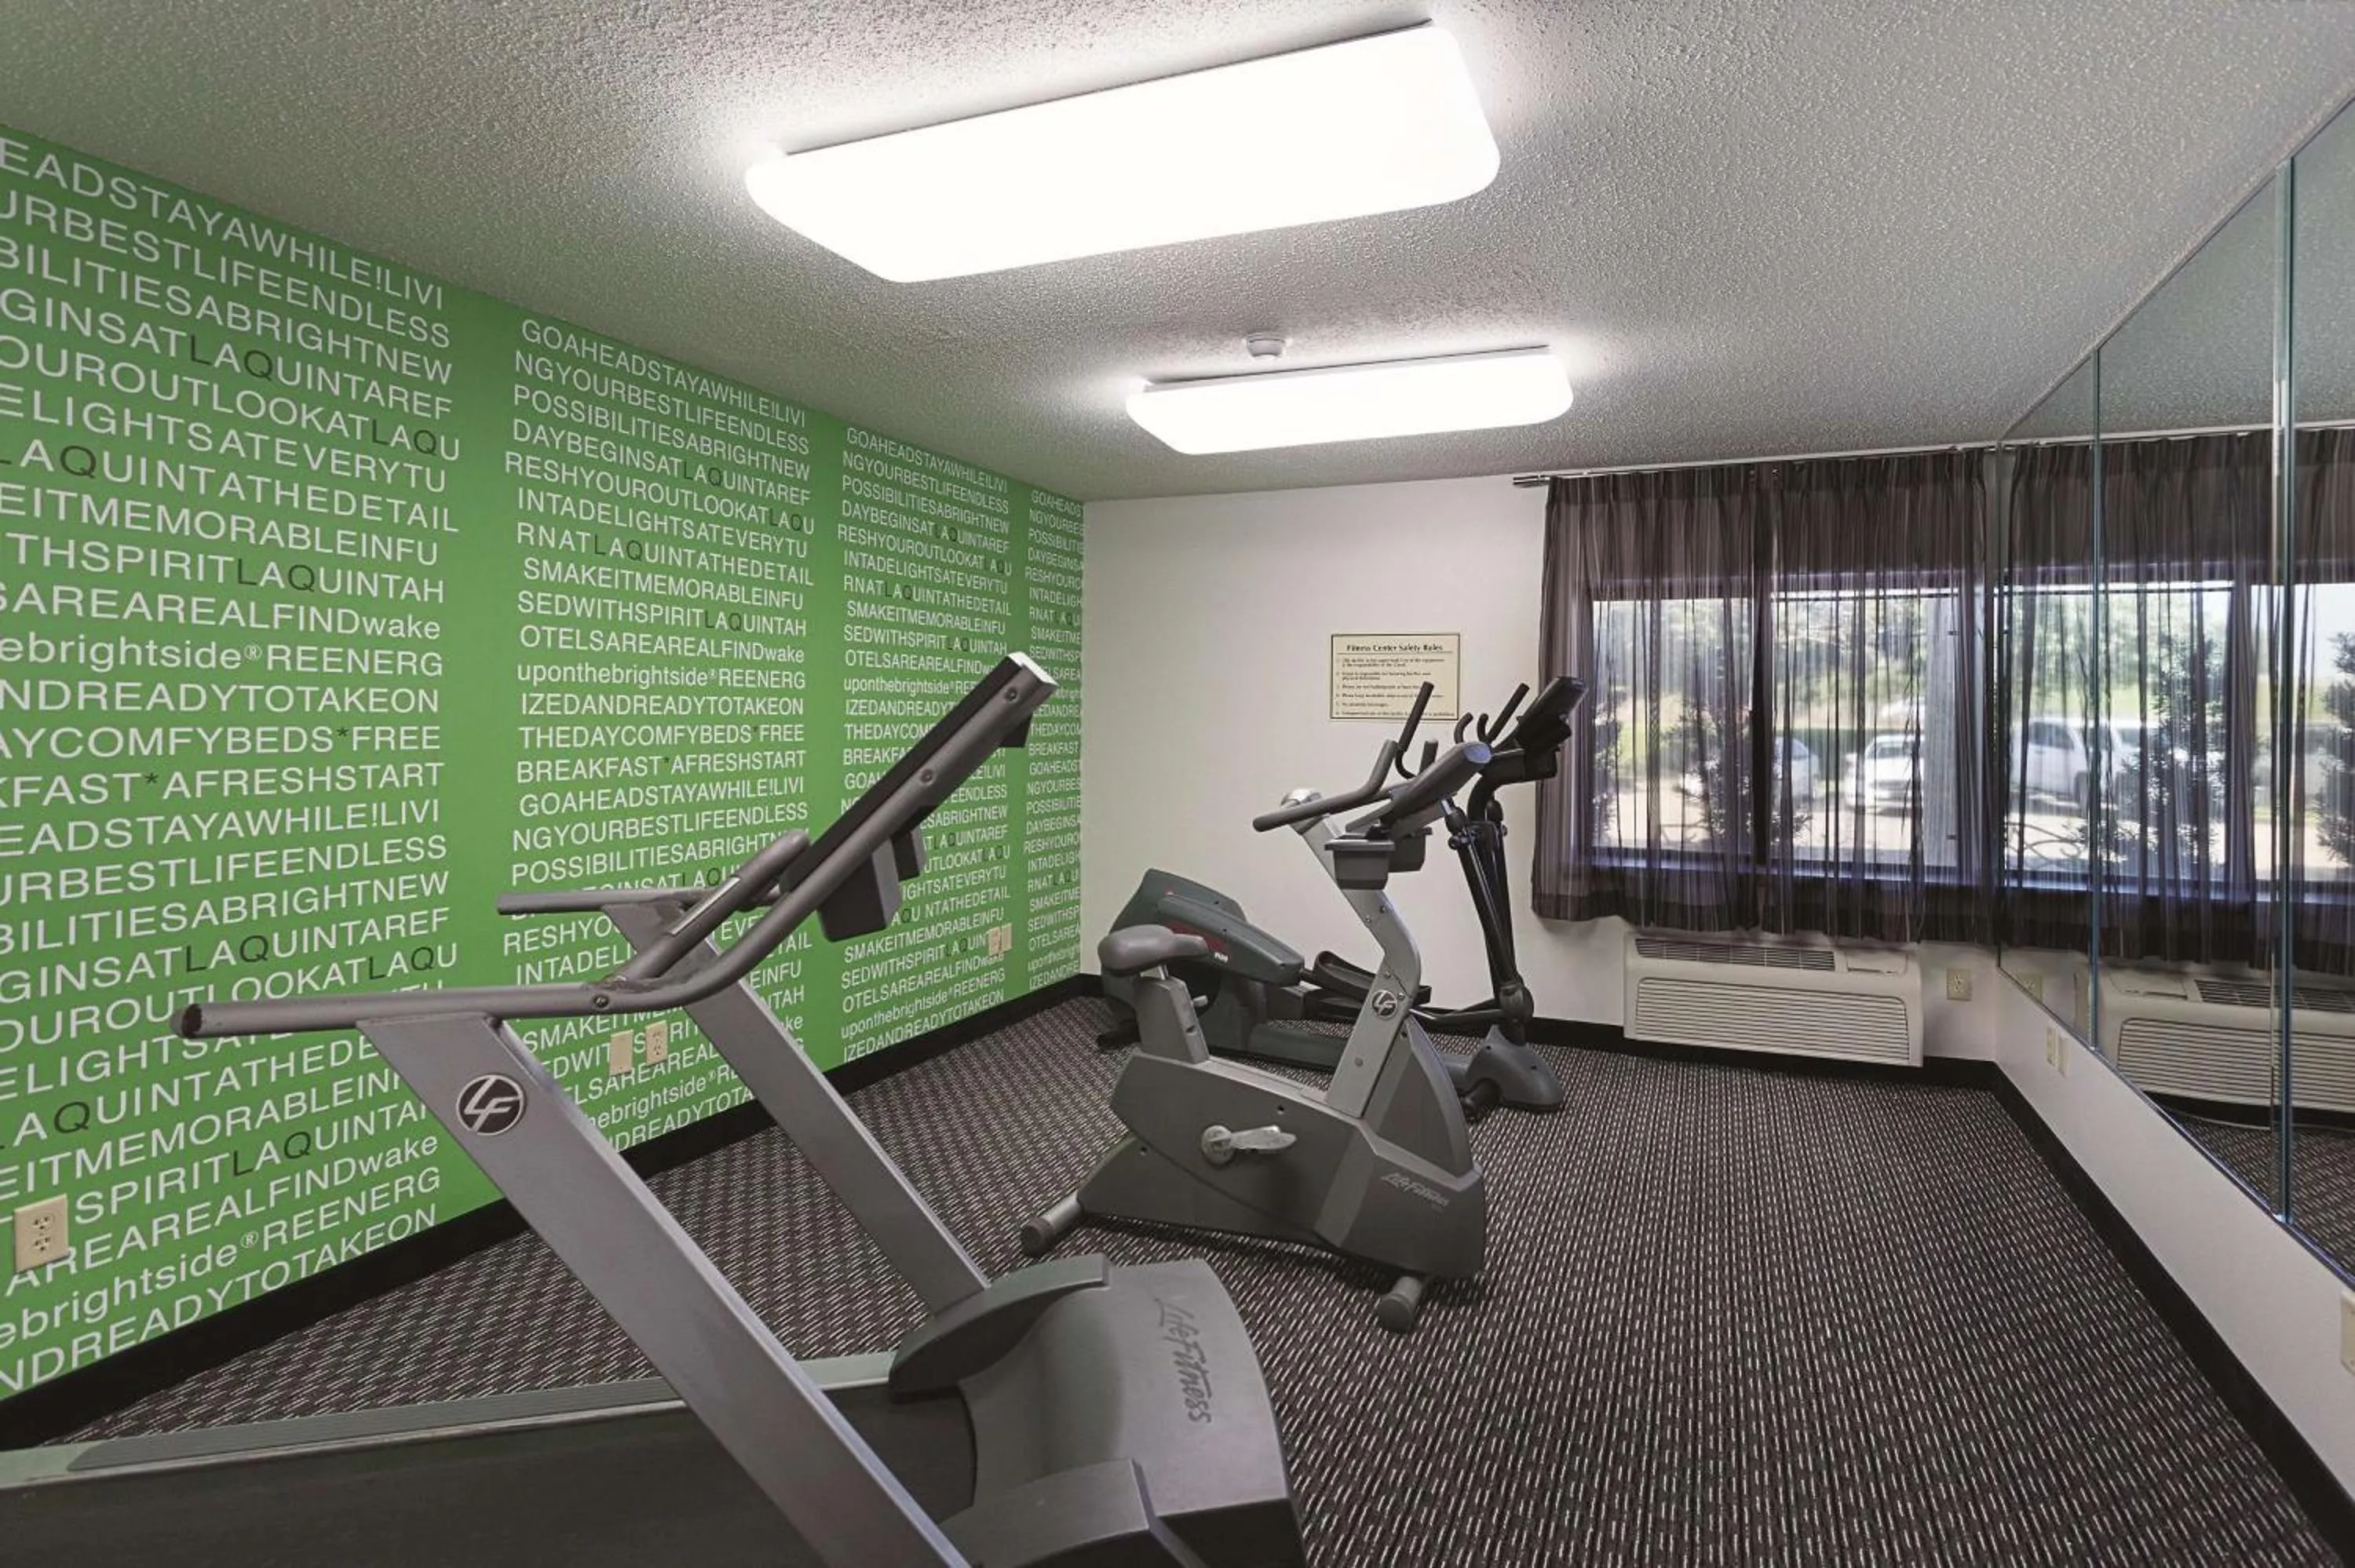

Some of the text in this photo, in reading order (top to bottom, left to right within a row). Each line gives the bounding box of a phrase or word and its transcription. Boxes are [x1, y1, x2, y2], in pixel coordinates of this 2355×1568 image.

[0, 288, 451, 420] GINSATLAQUINTAREF
[0, 336, 459, 461] OUROUTLOOKATLAQU
[514, 385, 810, 481] POSSIBILITIESABRIGHTNEW
[515, 351, 809, 455] NGYOURBESTLIFEENDLESS
[506, 451, 814, 534] RESHYOUROUTLOOKATLAQU
[513, 419, 811, 506] DAYBEGINSATLAQUINTAREF
[0, 485, 437, 565] EITMEMORABLEINFU
[517, 523, 814, 586] RNATLAQUINTATHEDETAIL
[518, 487, 808, 559] INTADELIGHTSATEVERYTU
[6, 532, 444, 603] THSPIRITLAQUINTAH
[524, 557, 803, 610] SMAKEITMEMORABLEINFU
[0, 582, 440, 640] AREAREALFINDwake
[517, 590, 806, 636] SEDWITHSPIRITLAQUINTAH
[520, 625, 805, 663] OTELSAREAREALFINDwake
[0, 680, 438, 713] NDREADYTOTAKEON
[521, 693, 803, 715] IZEDANDREADYTOTAKEON
[513, 802, 808, 851] NGYOURBESTLIFEENDLESS
[0, 907, 449, 1004] GINSATLAQUINTAREF
